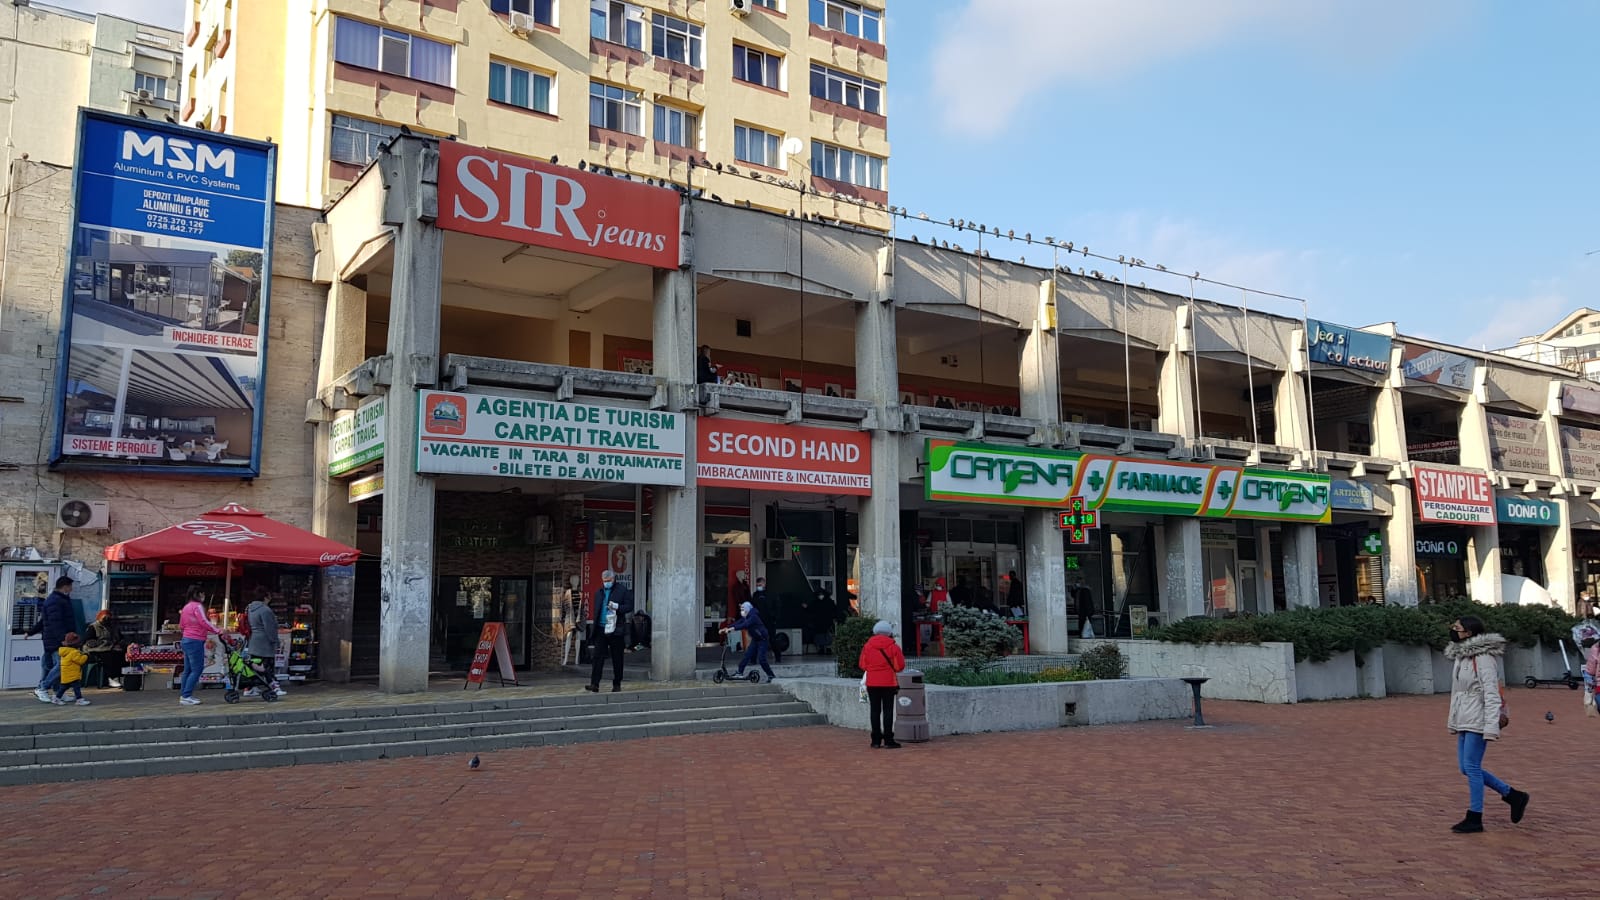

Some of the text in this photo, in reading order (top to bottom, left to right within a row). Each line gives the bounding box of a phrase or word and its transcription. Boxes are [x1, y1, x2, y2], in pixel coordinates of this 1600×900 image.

[122, 130, 235, 178] MSM
[113, 162, 240, 191] Aluminium & PVC Systems
[143, 189, 172, 202] DEPOZIT
[454, 155, 666, 253] SIR jeans
[143, 199, 209, 219] ALUMINIU & PVC
[221, 336, 254, 349] TERASE
[353, 414, 361, 430] DE
[362, 400, 385, 424] TURISM
[574, 406, 600, 424] DE
[605, 408, 675, 430] TURISM
[356, 423, 378, 446] TRAVEL
[587, 428, 660, 450] TRAVEL
[72, 438, 158, 455] SISTEME PERGOLE
[429, 443, 683, 470] VACANTE IN TARA SI STRAINATATE
[708, 431, 860, 463] SECOND HAND
[499, 462, 625, 480] BILETE DE AVION
[697, 465, 869, 487] IMBRACAMINTE & INCALTAMINTE
[1117, 471, 1203, 495] FARMACIE
[1424, 502, 1490, 514] PERSONALIZARE
[1436, 511, 1480, 522] CADOURI
[1508, 503, 1538, 519] DONA
[1416, 540, 1445, 554] DONA
